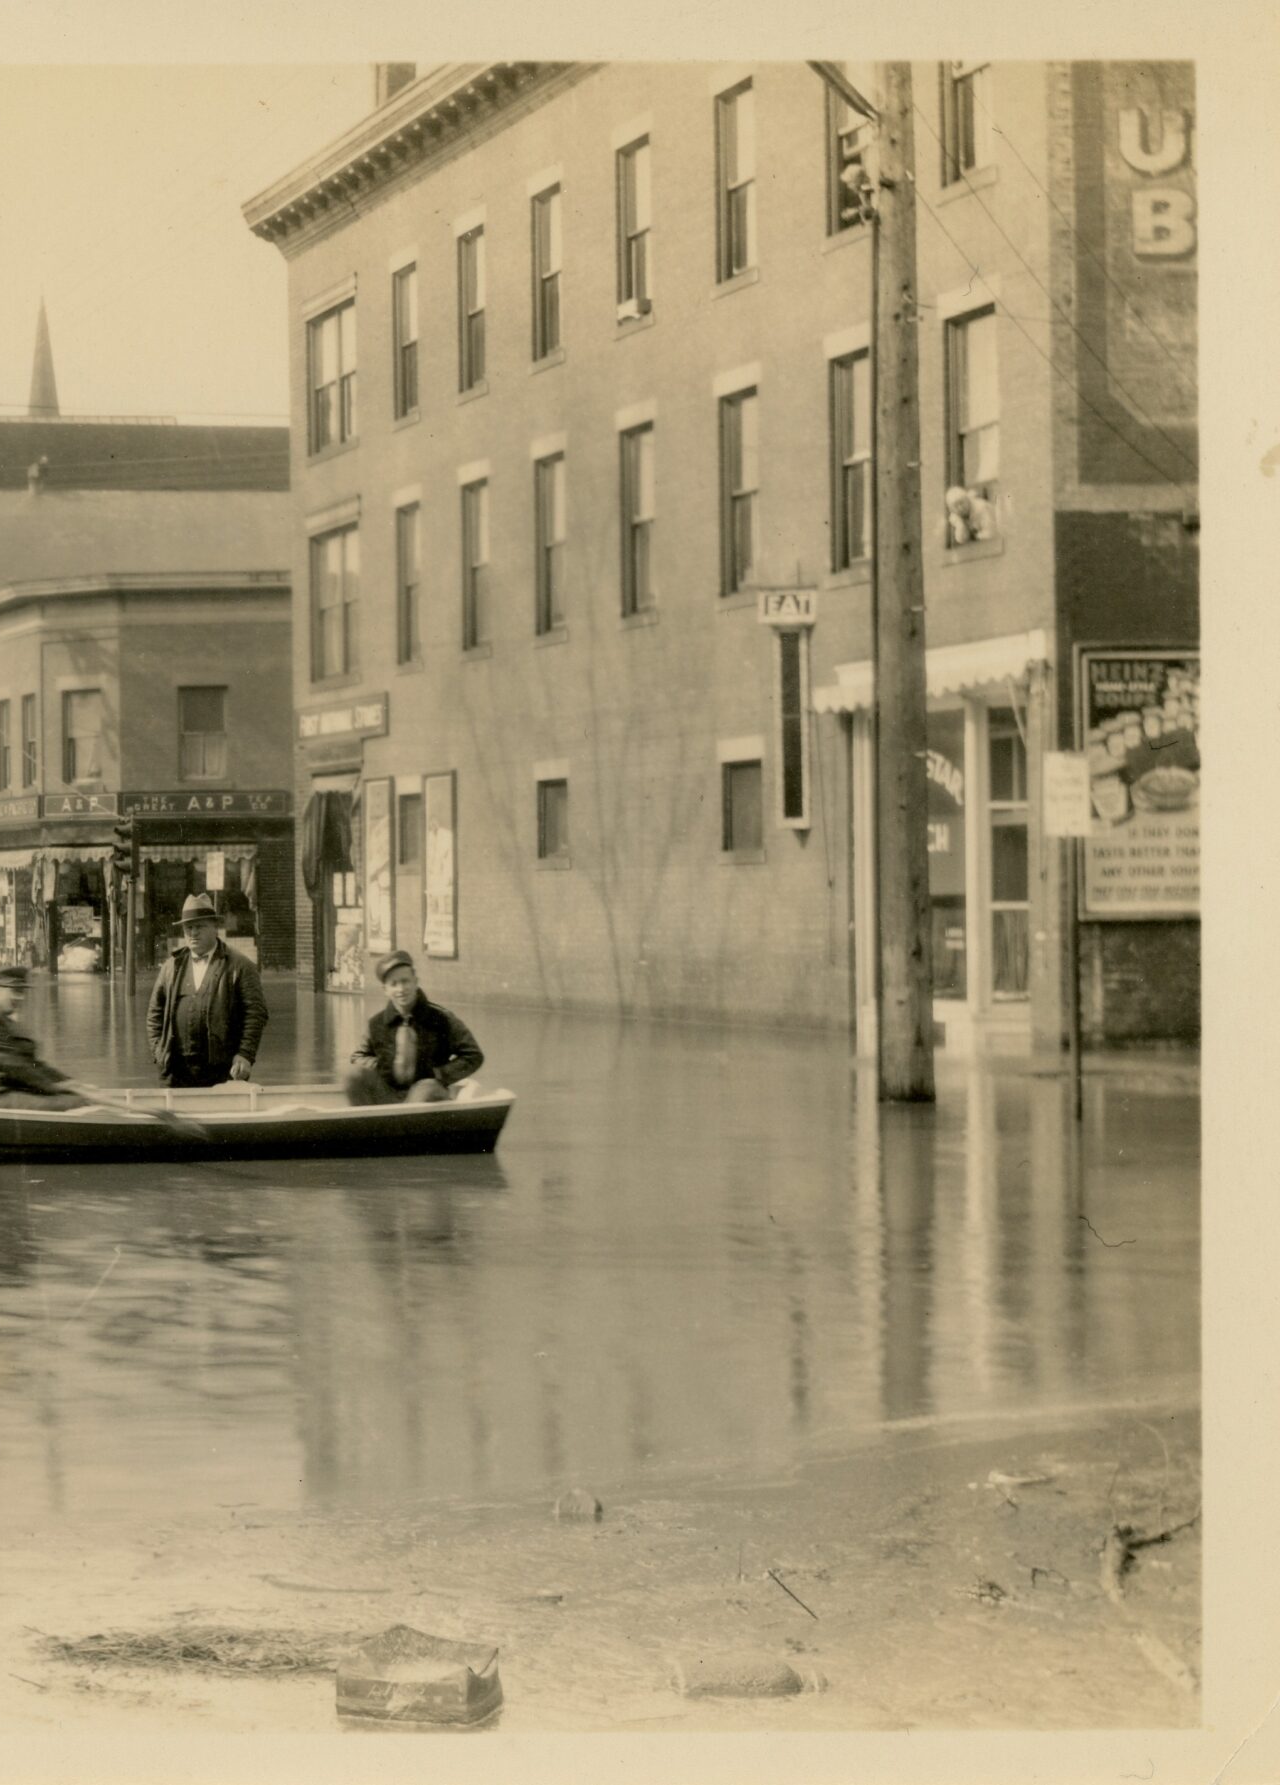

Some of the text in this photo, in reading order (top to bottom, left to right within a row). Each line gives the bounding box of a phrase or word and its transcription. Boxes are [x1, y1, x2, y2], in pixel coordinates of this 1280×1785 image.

[765, 594, 810, 615] EAT
[1090, 662, 1164, 682] HEINZ
[1095, 693, 1157, 707] SOUPS
[143, 796, 168, 804] THE
[248, 795, 273, 803] TEA
[134, 803, 176, 811] GREAT
[1143, 826, 1170, 838] THEY
[1093, 847, 1200, 858] TASTE BETTER THA
[1101, 866, 1122, 878] ANY
[1128, 866, 1164, 878] OTHER
